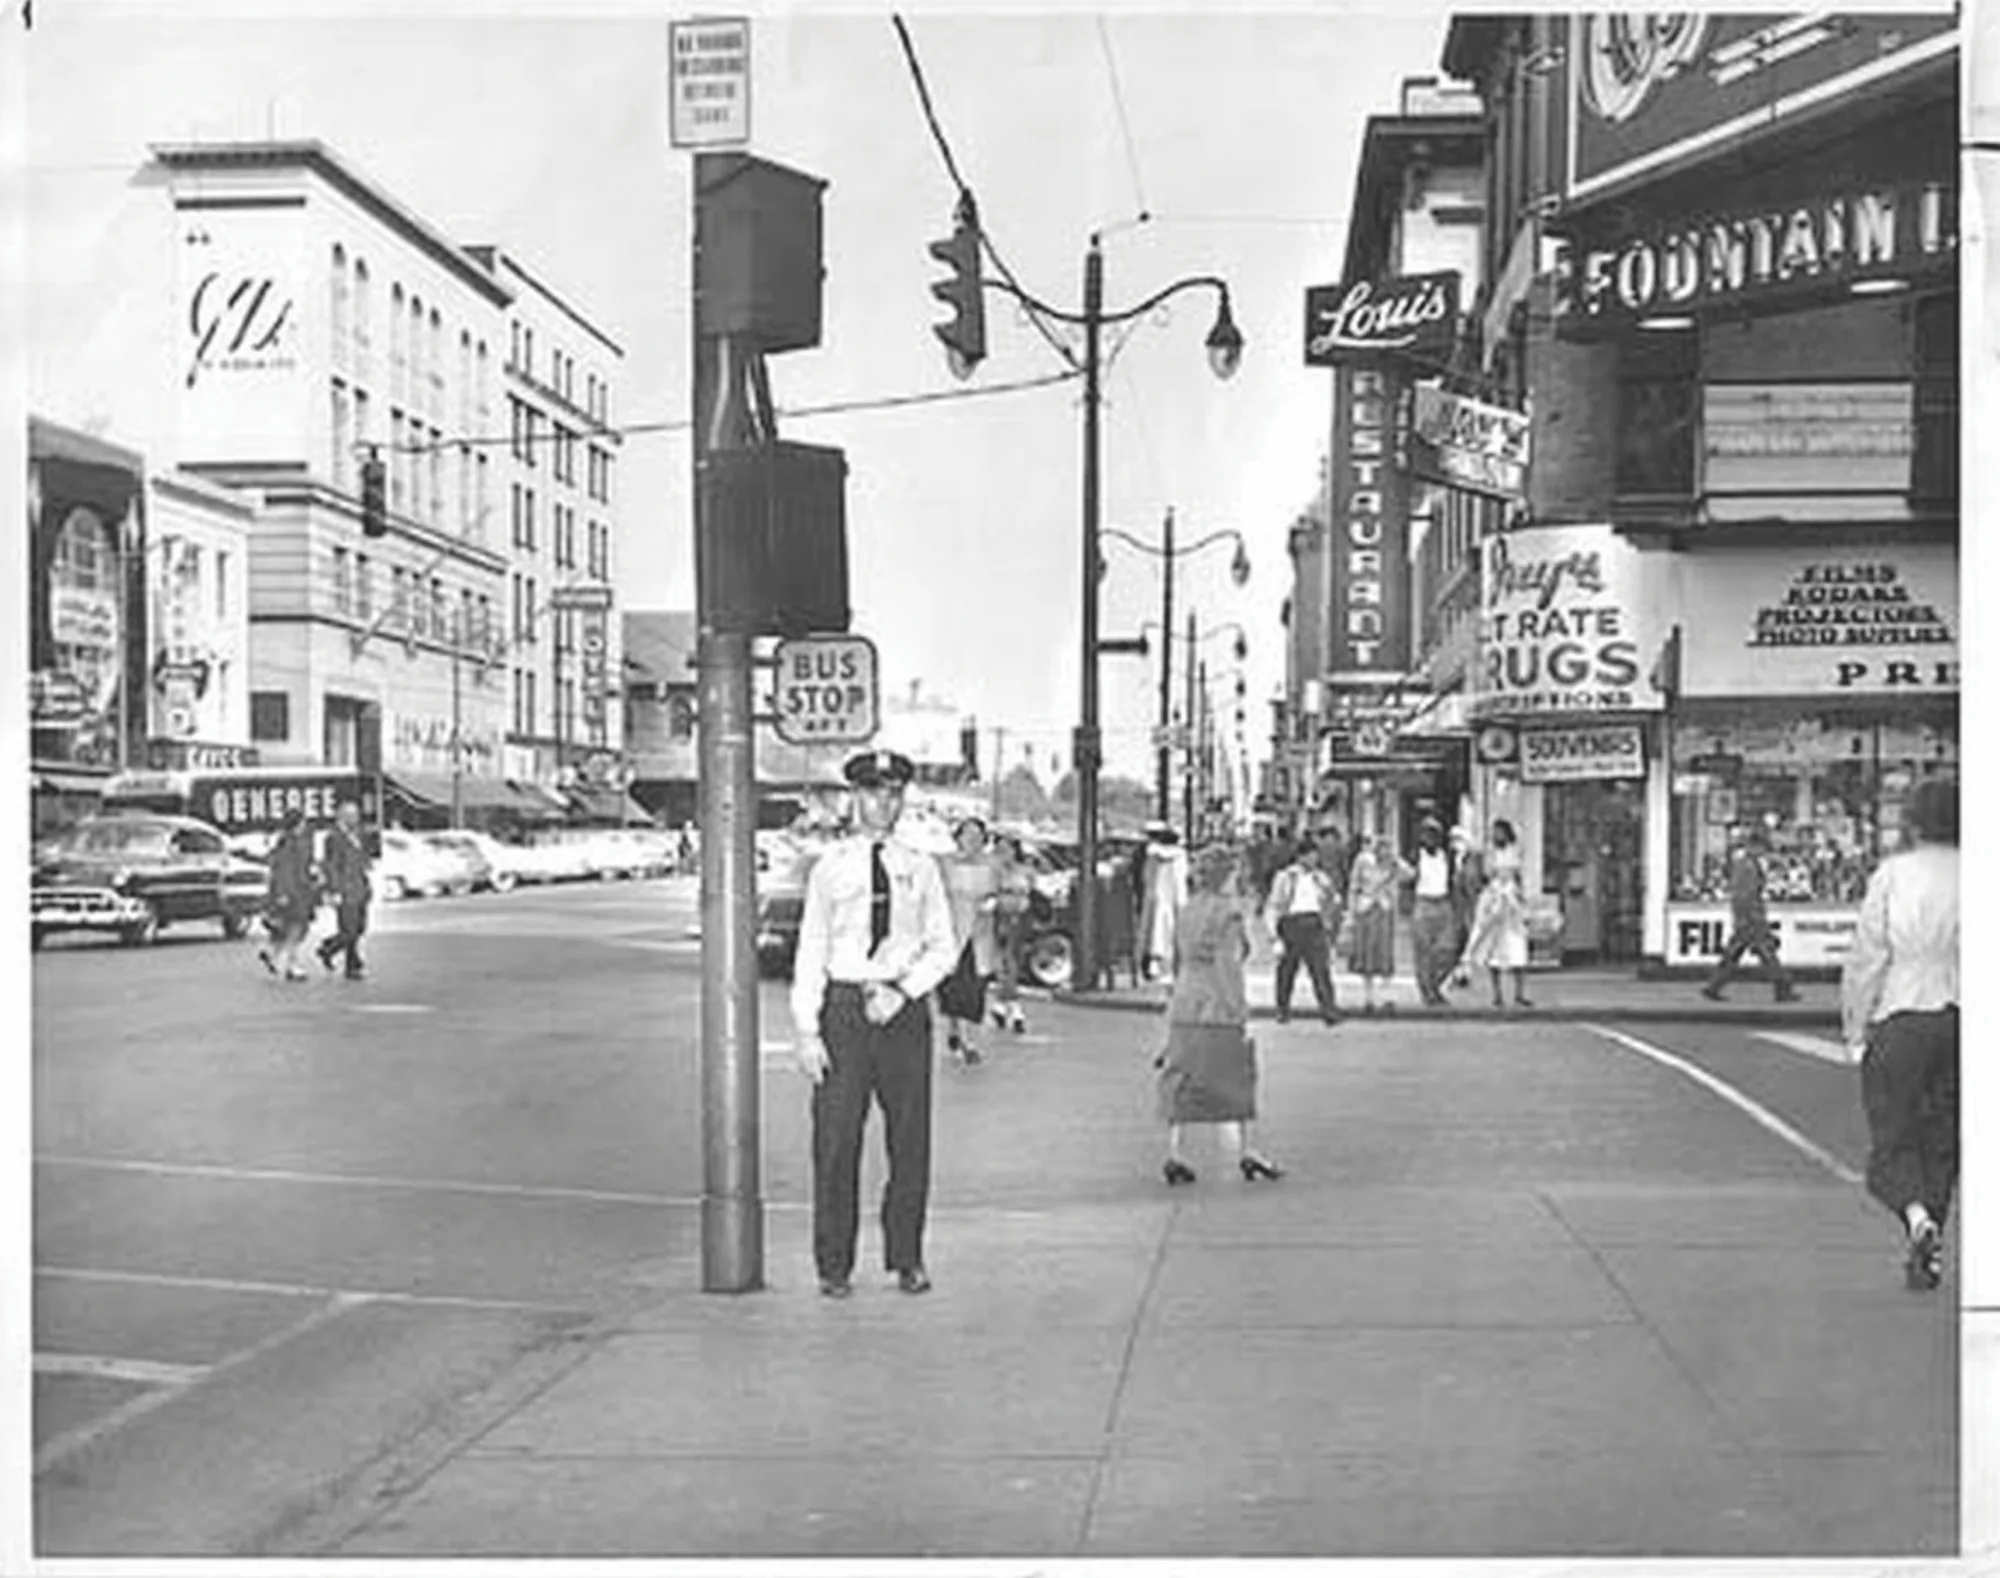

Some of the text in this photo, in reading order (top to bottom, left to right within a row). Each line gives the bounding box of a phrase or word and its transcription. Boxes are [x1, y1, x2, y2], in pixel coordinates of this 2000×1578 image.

[1586, 193, 1896, 315] FOUNTAIN
[1311, 280, 1446, 355] Louis
[1349, 371, 1385, 667] RESTAURANT
[1792, 563, 1898, 584] FILMS
[1518, 607, 1620, 639] RATE
[794, 650, 857, 680] BUS
[786, 686, 865, 715] STOP
